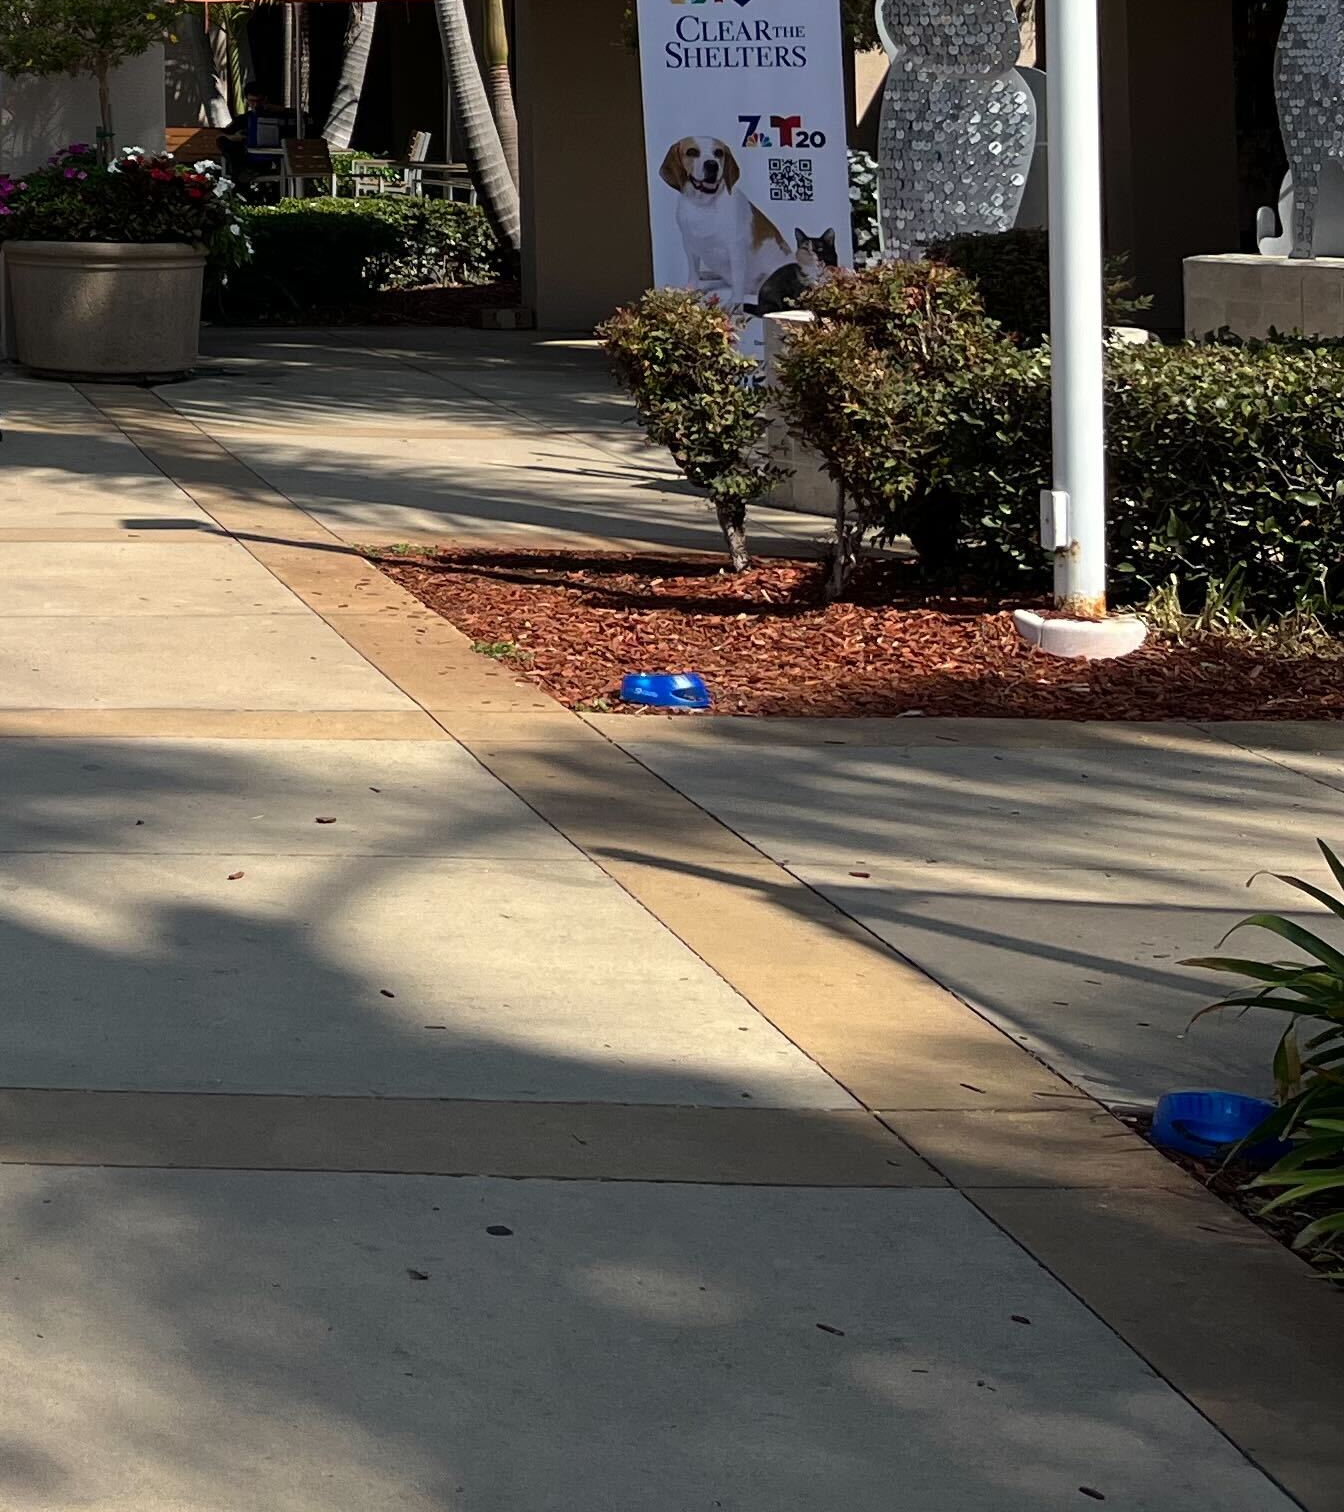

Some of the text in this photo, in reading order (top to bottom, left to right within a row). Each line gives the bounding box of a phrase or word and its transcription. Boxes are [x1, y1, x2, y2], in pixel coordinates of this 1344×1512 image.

[676, 15, 805, 43] CLEAR THE
[665, 41, 807, 68] SHELTERS
[738, 115, 761, 148] 7
[795, 131, 826, 148] 20
